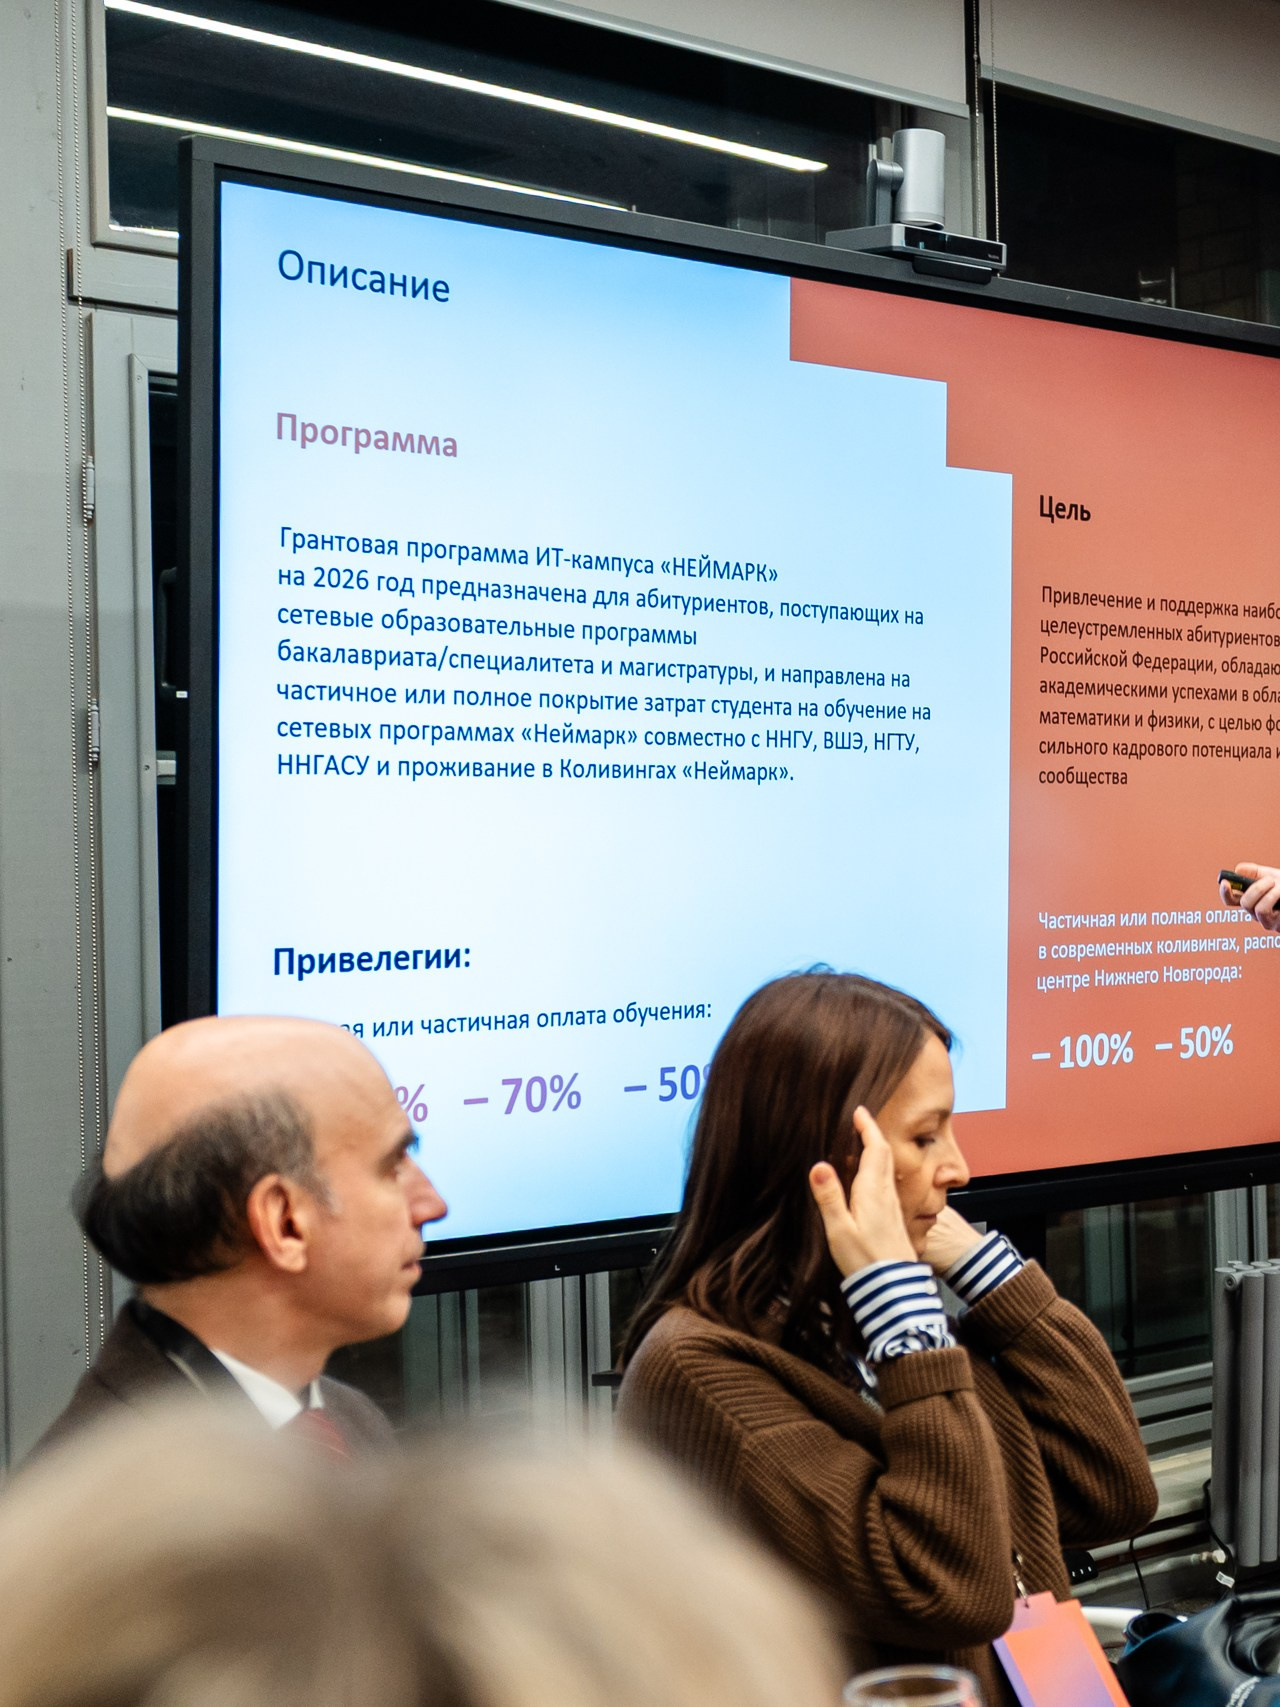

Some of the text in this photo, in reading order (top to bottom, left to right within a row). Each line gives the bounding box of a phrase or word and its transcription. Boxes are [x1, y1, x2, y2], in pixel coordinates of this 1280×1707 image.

[278, 250, 449, 302] Описание
[276, 413, 457, 457] Программа
[1039, 495, 1091, 523] Цель
[280, 527, 777, 582] Грантовая программа ИТ-кампуса «НЕЙМАРК»
[278, 567, 923, 626] на 2026 год предназначена для абитуриентов, поступающих на
[1042, 586, 1142, 609] Привлечение
[1147, 598, 1155, 610] и
[1160, 599, 1238, 618] поддержка
[277, 608, 696, 646] сетевые образовательные программы
[1040, 620, 1182, 641] целеустремленных
[1186, 625, 1280, 648] абитуриентов
[277, 639, 909, 688] бакалавриата/специалитета и магистратуры, и направлена на
[1040, 647, 1127, 667] Российской
[1132, 652, 1216, 674] Федерации,
[276, 684, 930, 722] частичное или полное покрытие затрат студента на обучение на
[1039, 681, 1167, 698] академическими
[1171, 687, 1237, 703] успехами
[1241, 690, 1248, 701] в
[1039, 711, 1129, 726] математики
[1134, 715, 1142, 727] и
[1147, 710, 1203, 732] физики,
[1207, 717, 1214, 729] с
[1218, 718, 1262, 733] целью
[277, 722, 919, 754] сетевых программах «Неймарк» совместно с ННГУ, ВШЭ, НГТУ,
[1038, 741, 1107, 755] сильного
[1112, 743, 1187, 760] кадрового
[1192, 745, 1271, 761] потенциала
[278, 754, 793, 785] ННГАСУ и проживание в Коливингах «Неймарк».
[1038, 766, 1127, 788] сообщества
[1038, 910, 1251, 929] Частичная или полная оплата
[274, 948, 469, 981] Привелегии:
[1038, 946, 1046, 959] в
[1051, 941, 1152, 961] современных
[1156, 938, 1239, 953] коливингах,
[1037, 966, 1241, 993] центре Нижнего Новгорода:
[373, 1021, 413, 1037] или
[420, 1014, 529, 1034] частичная
[536, 1010, 606, 1027] оплата
[612, 1002, 711, 1027] обучения:
